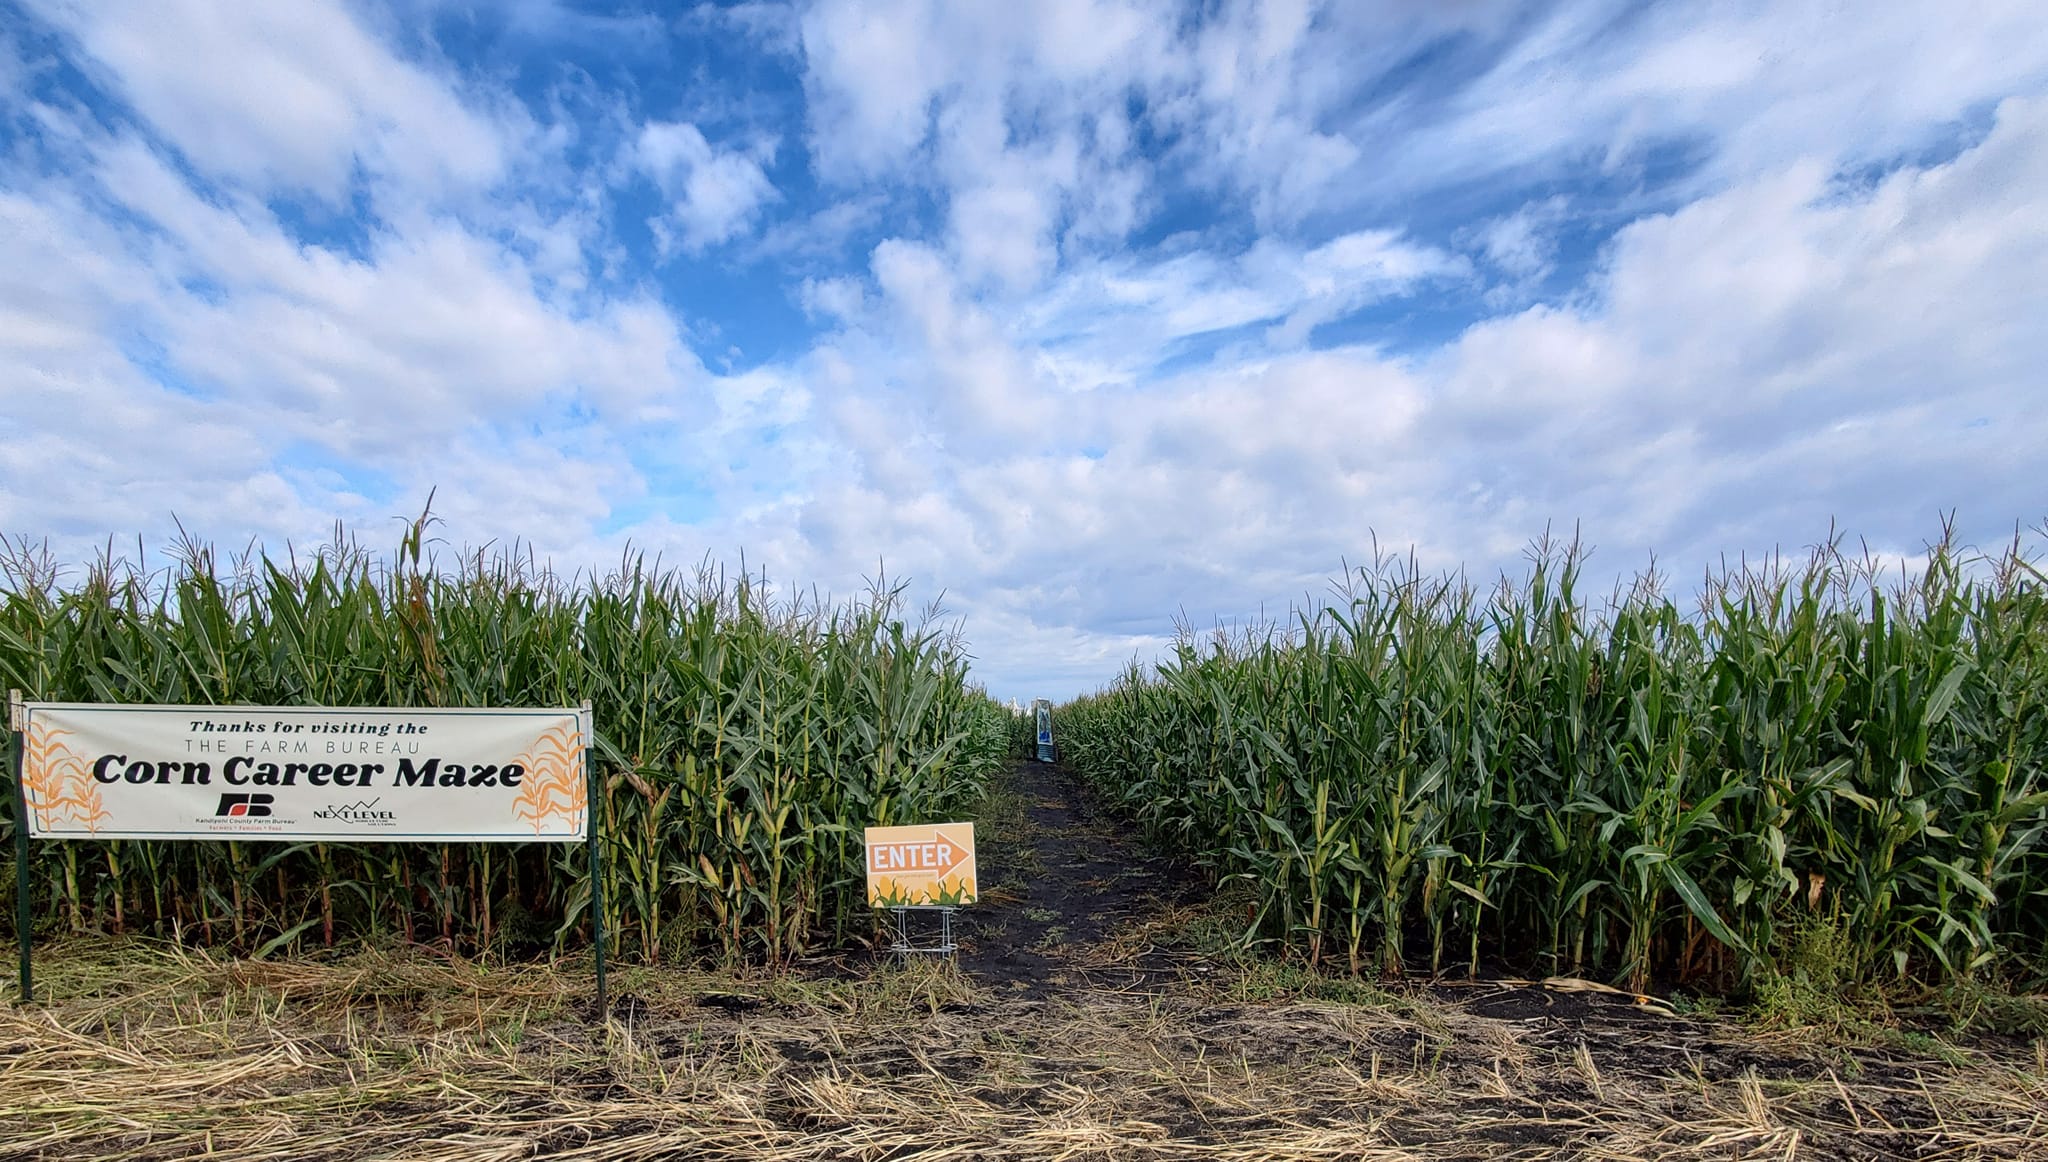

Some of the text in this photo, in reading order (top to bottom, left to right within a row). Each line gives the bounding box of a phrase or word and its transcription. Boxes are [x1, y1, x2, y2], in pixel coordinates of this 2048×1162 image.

[190, 720, 428, 737] Thanks for visiting the
[184, 739, 420, 754] THE FARM BUREAU
[92, 754, 525, 788] Corn Career Maze
[353, 811, 397, 820] LEVEL
[873, 843, 952, 869] ENTER
